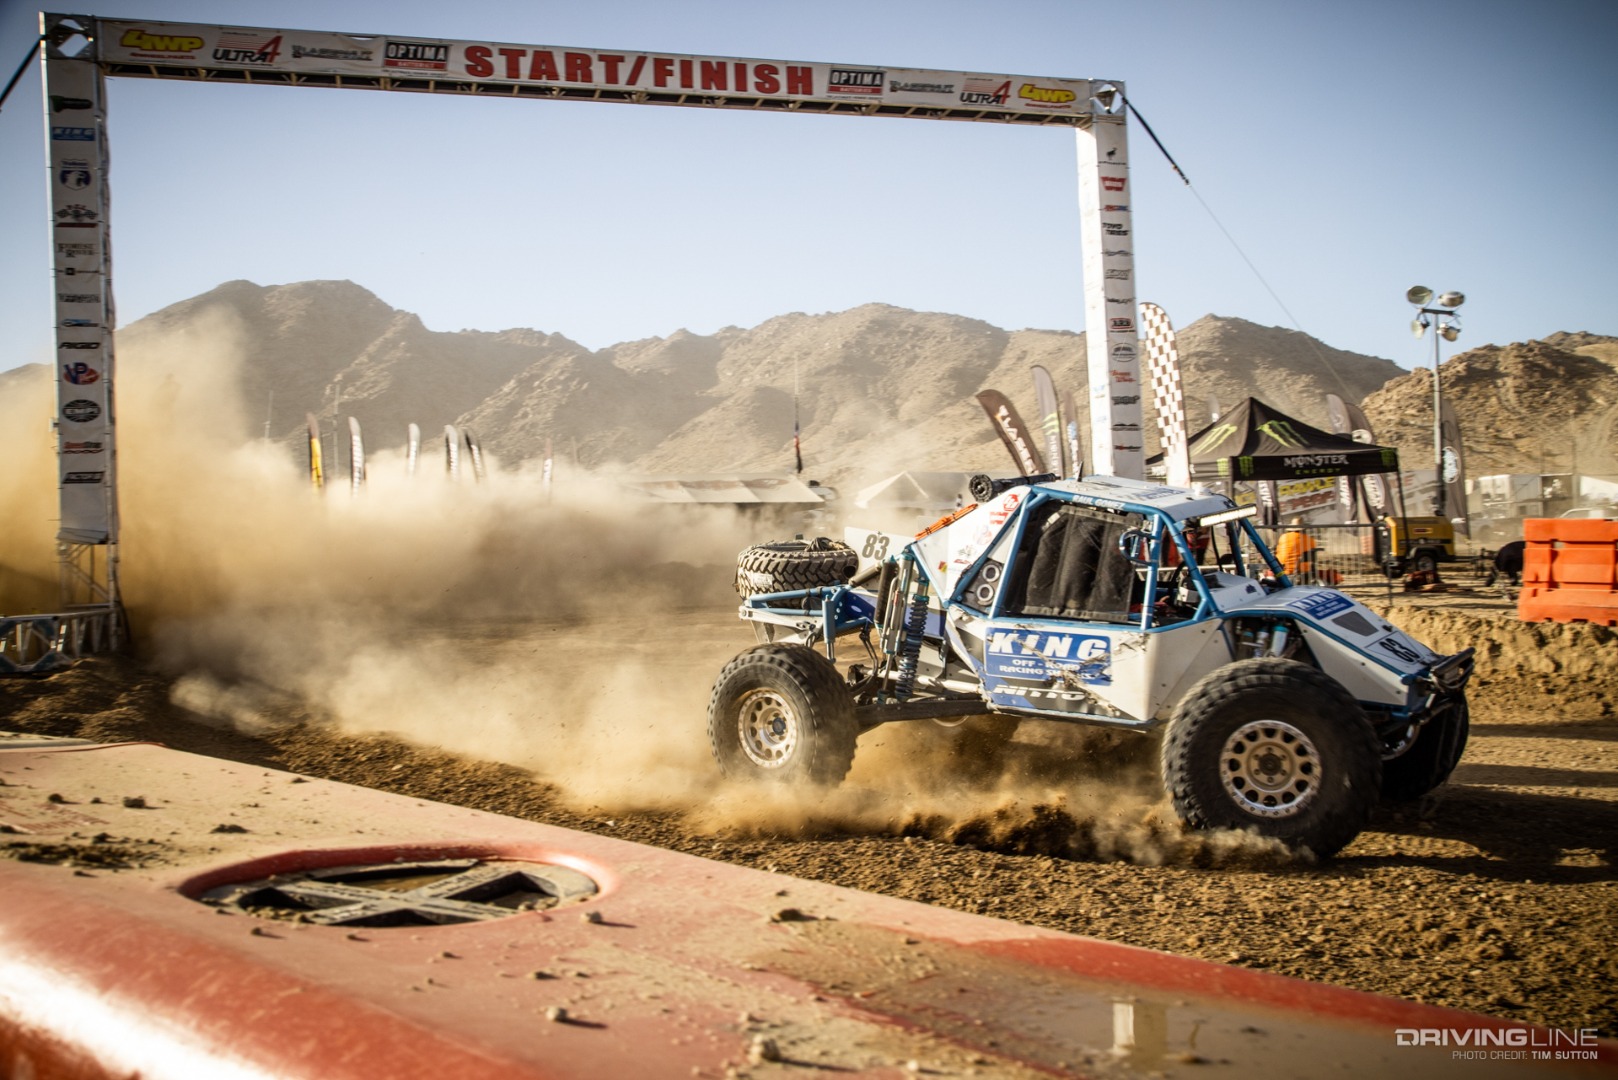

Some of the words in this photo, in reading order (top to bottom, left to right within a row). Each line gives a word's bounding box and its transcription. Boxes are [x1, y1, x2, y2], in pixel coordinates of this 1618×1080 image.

[387, 44, 446, 61] OPTIMA
[464, 46, 814, 95] START/FINISH
[831, 71, 881, 85] OPTIMA
[1283, 454, 1350, 468] MONSTER
[861, 533, 890, 561] 83
[988, 631, 1108, 660] KING
[999, 665, 1044, 675] RACING
[1012, 658, 1036, 667] OFF
[992, 684, 1086, 701] NITTO
